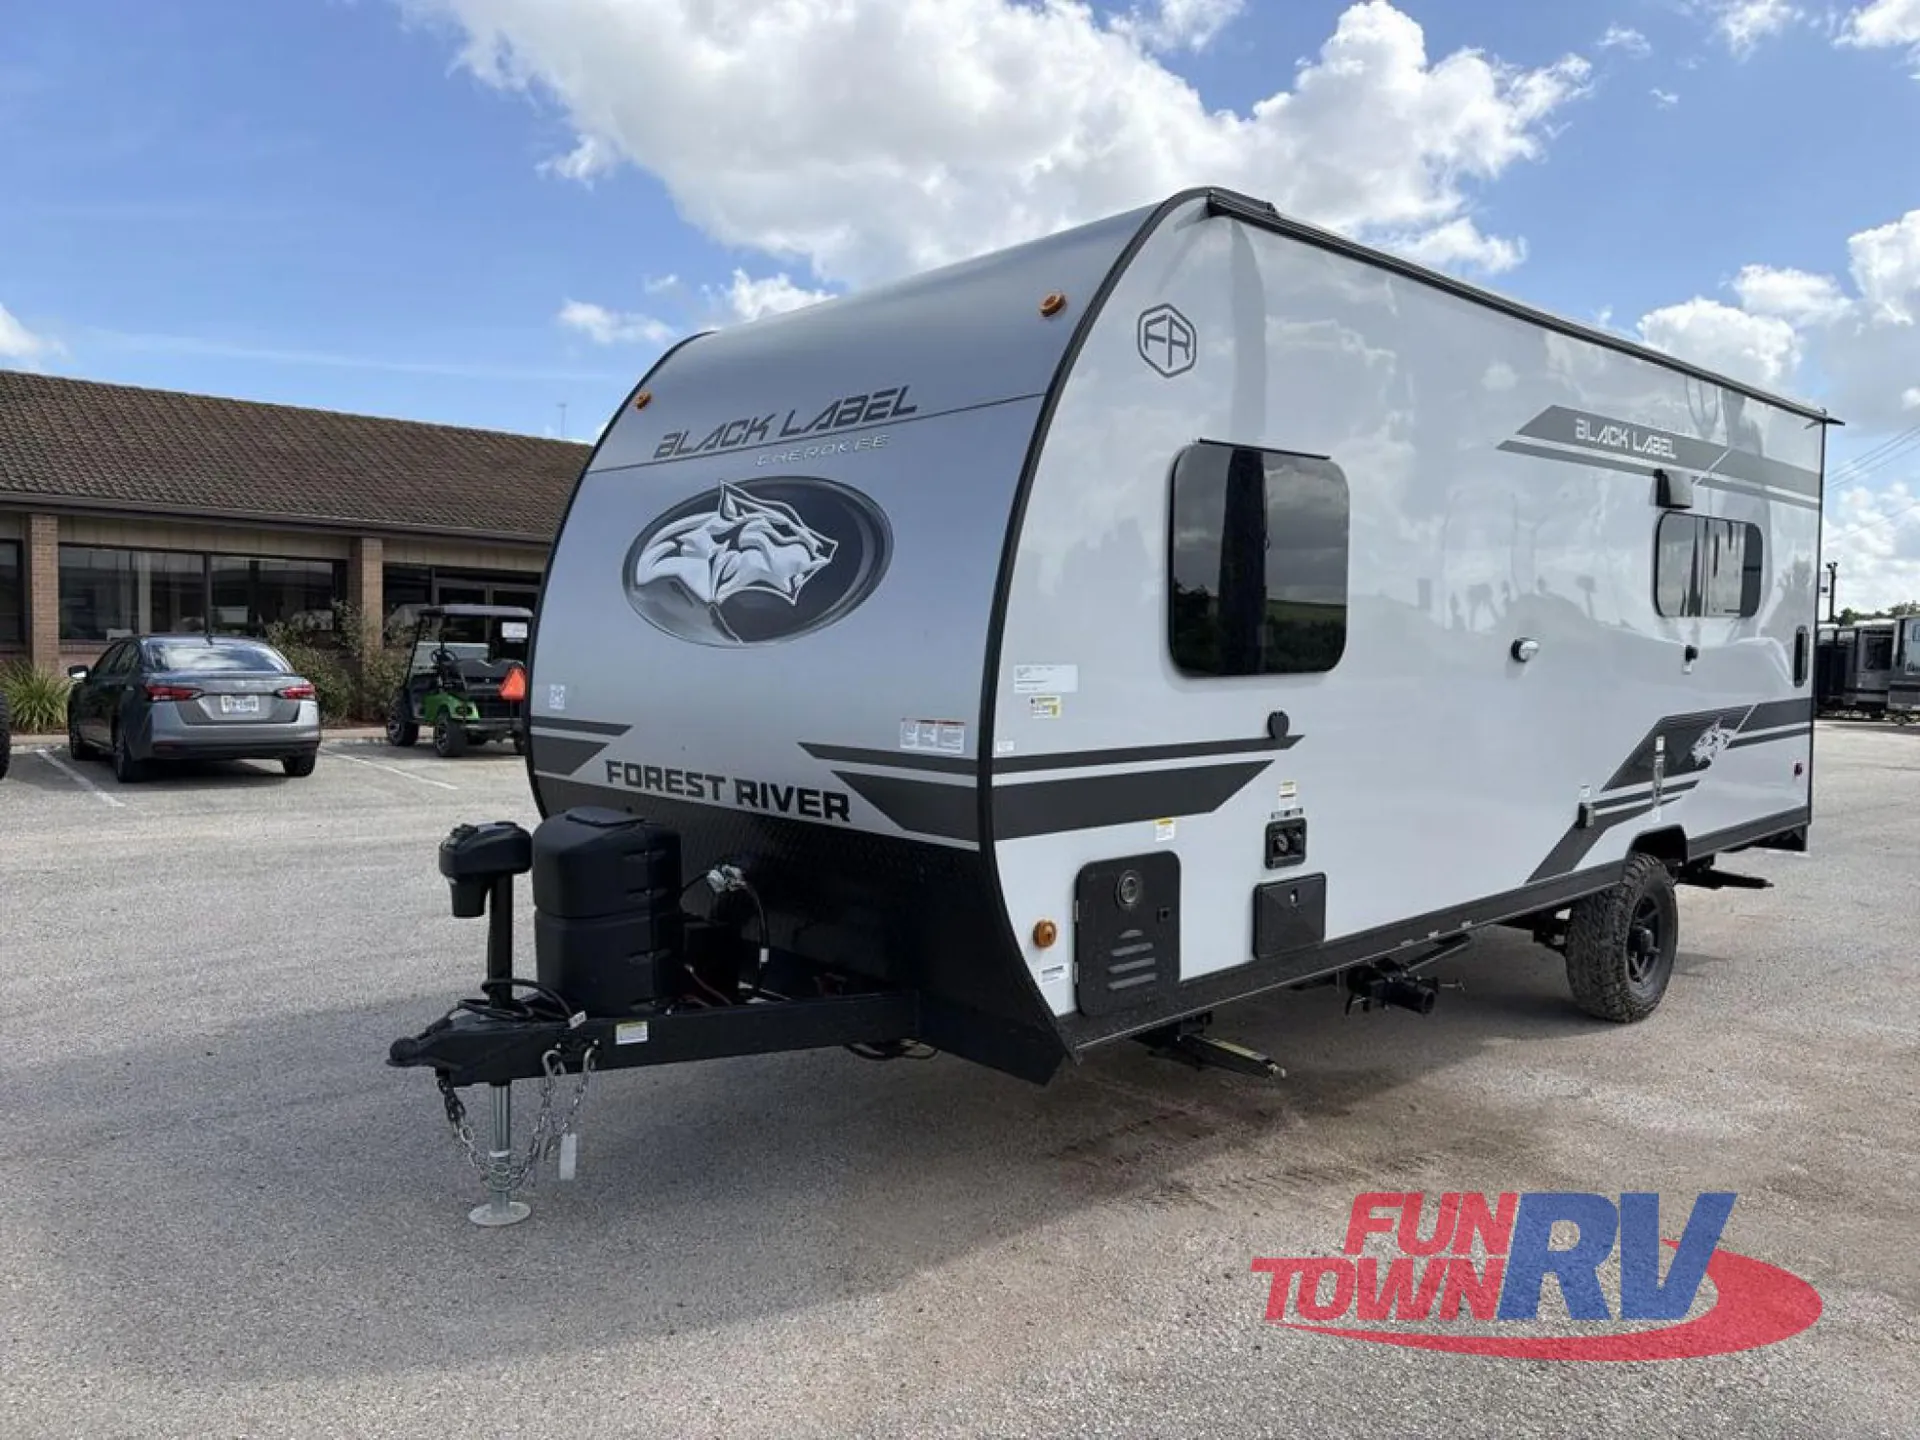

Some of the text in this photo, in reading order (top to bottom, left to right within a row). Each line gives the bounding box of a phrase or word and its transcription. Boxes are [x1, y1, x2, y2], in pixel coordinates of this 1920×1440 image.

[653, 384, 918, 460] BLACK LABEL
[1575, 418, 1678, 459] BLACK LABEL
[754, 434, 891, 467] CHEROKEE
[605, 759, 851, 822] FOREST RIVER
